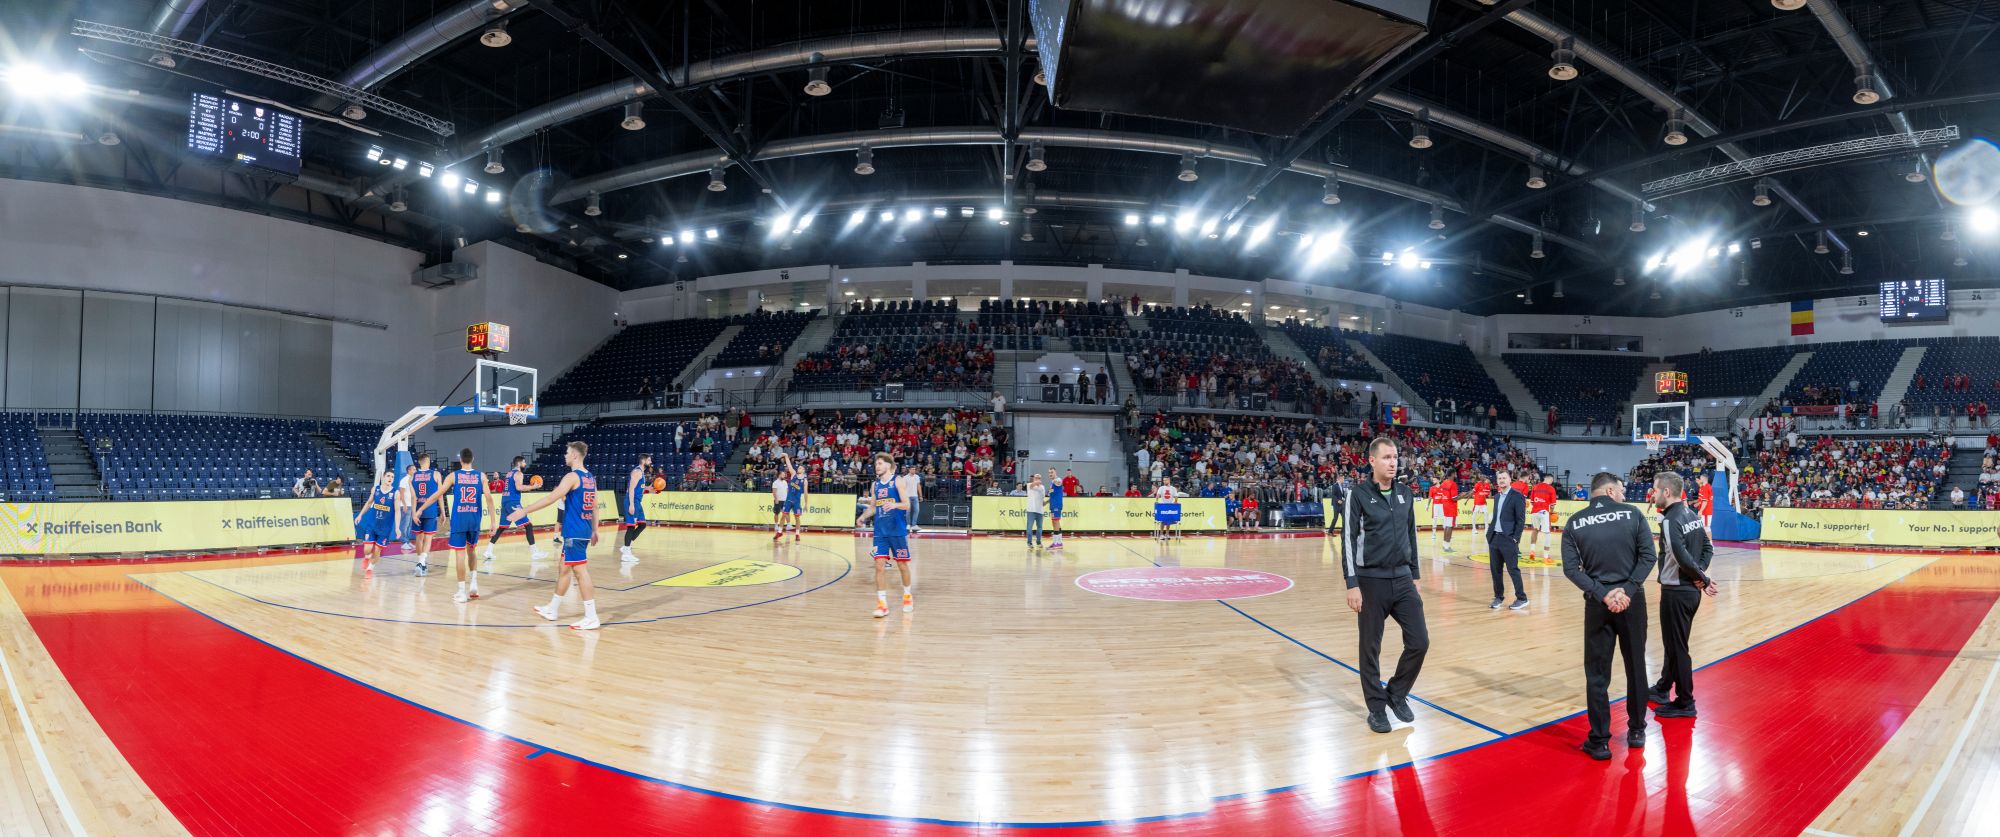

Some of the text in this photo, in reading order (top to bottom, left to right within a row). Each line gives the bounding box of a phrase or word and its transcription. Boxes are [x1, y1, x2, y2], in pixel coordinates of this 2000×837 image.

[242, 129, 259, 139] 2:00
[419, 483, 426, 496] 9
[460, 486, 477, 503] 12
[877, 488, 888, 498] 23
[583, 491, 595, 510] 55
[44, 520, 162, 534] Raiffeisen Bank
[236, 514, 330, 530] Raiffeisen Bank
[1573, 510, 1632, 530] LINKSOFT
[1779, 521, 1797, 529] Your
[1823, 522, 1870, 531] supporter!
